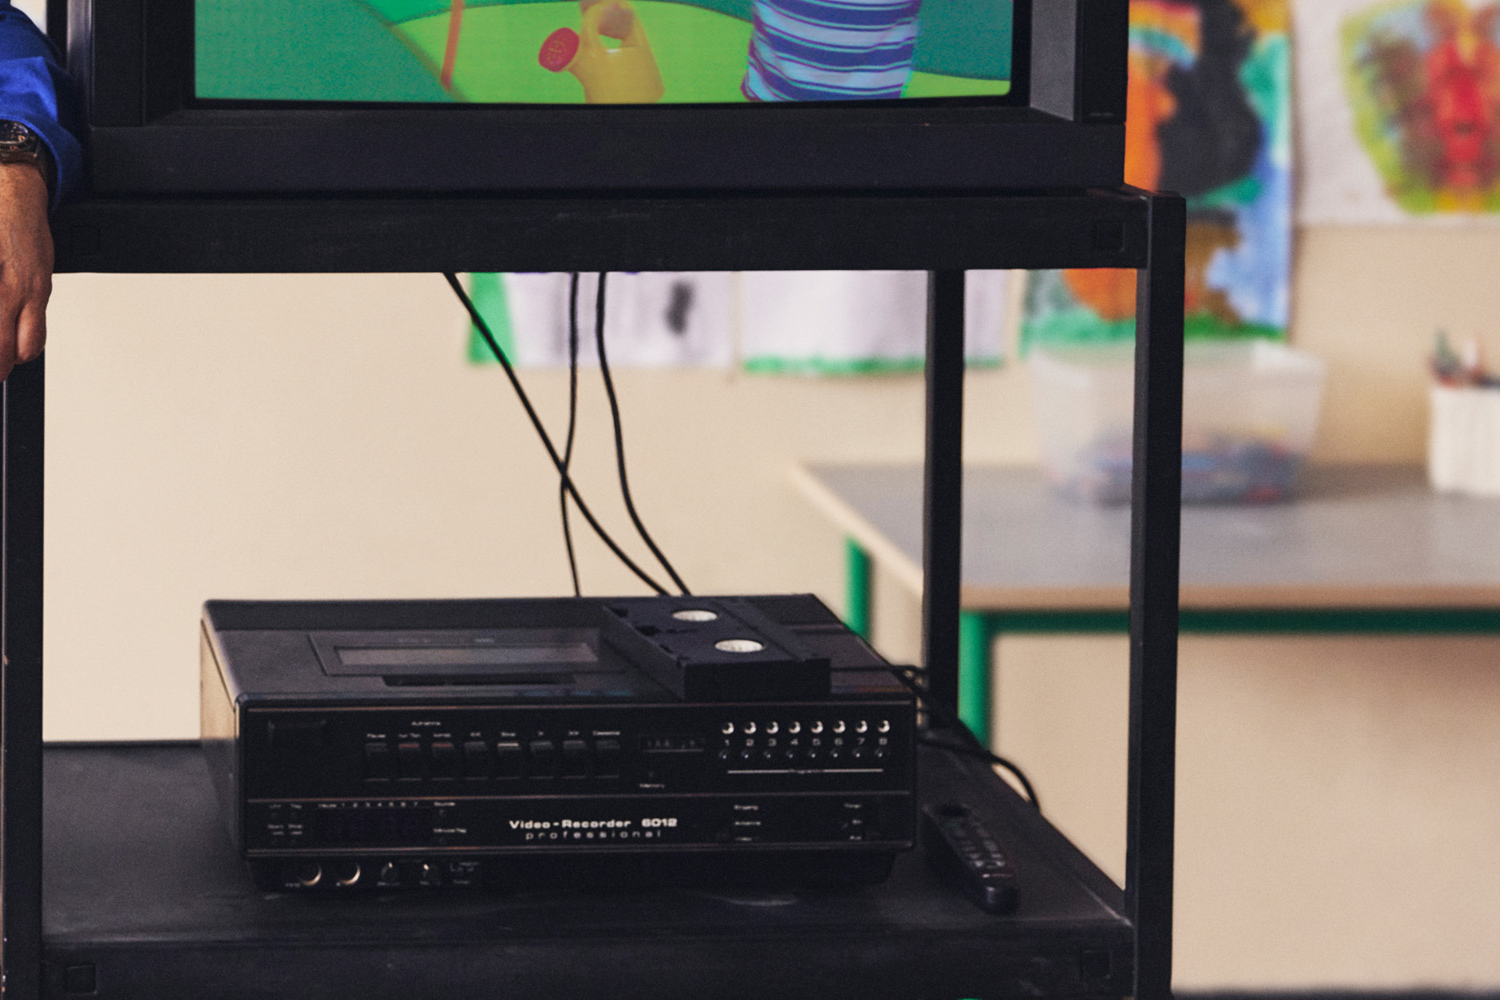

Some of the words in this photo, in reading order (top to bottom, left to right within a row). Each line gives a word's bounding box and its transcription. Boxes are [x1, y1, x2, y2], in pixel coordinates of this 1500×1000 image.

[509, 819, 631, 829] Video-Recorder
[641, 818, 677, 828] 6012
[526, 830, 661, 840] professional
